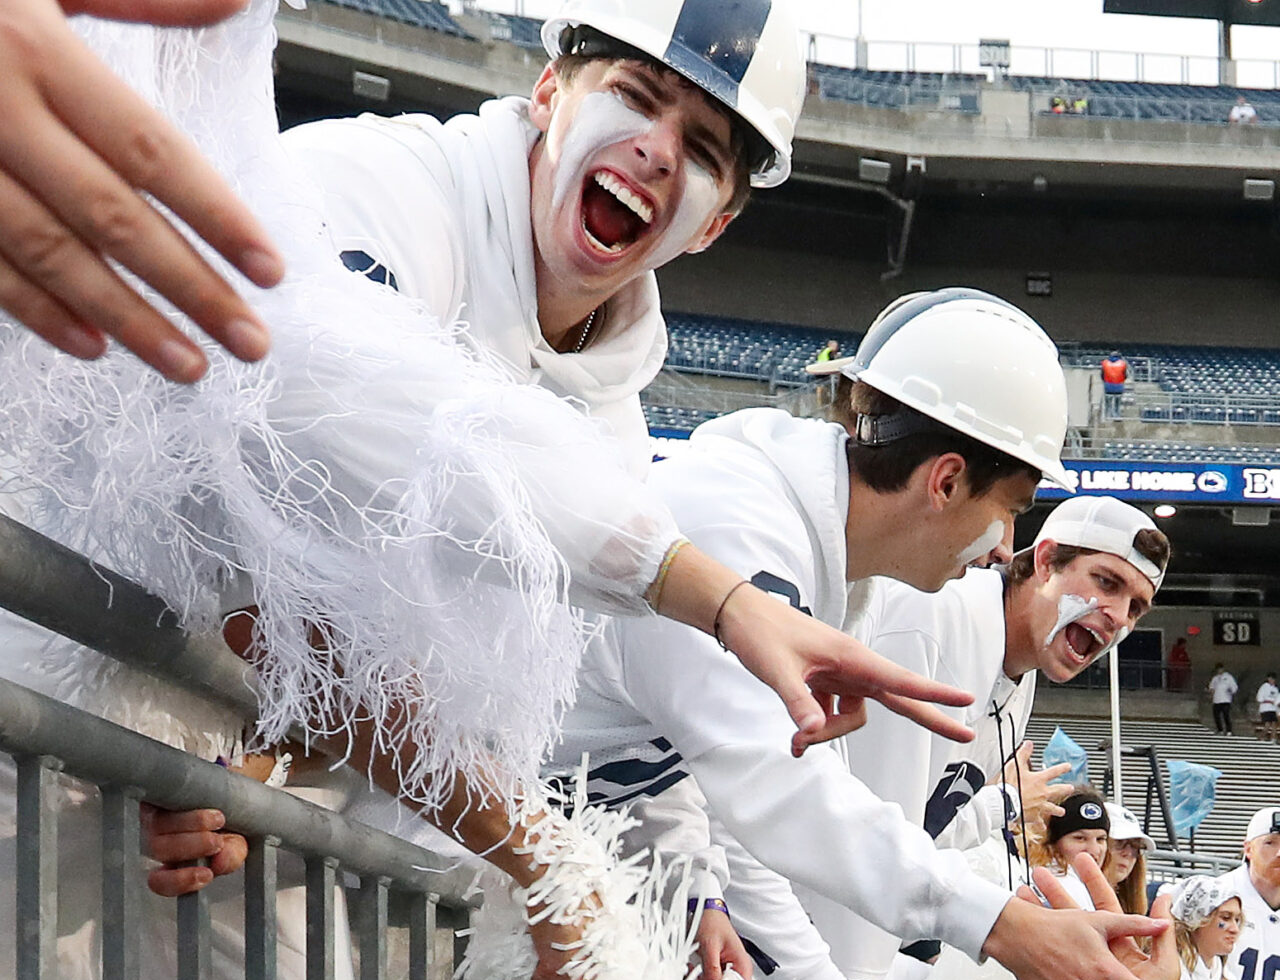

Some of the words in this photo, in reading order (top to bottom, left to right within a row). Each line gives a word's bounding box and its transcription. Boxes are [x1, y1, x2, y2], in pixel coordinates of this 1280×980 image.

[1081, 471, 1129, 491] LIKE
[1132, 473, 1197, 492] HOME
[1222, 622, 1251, 643] SD
